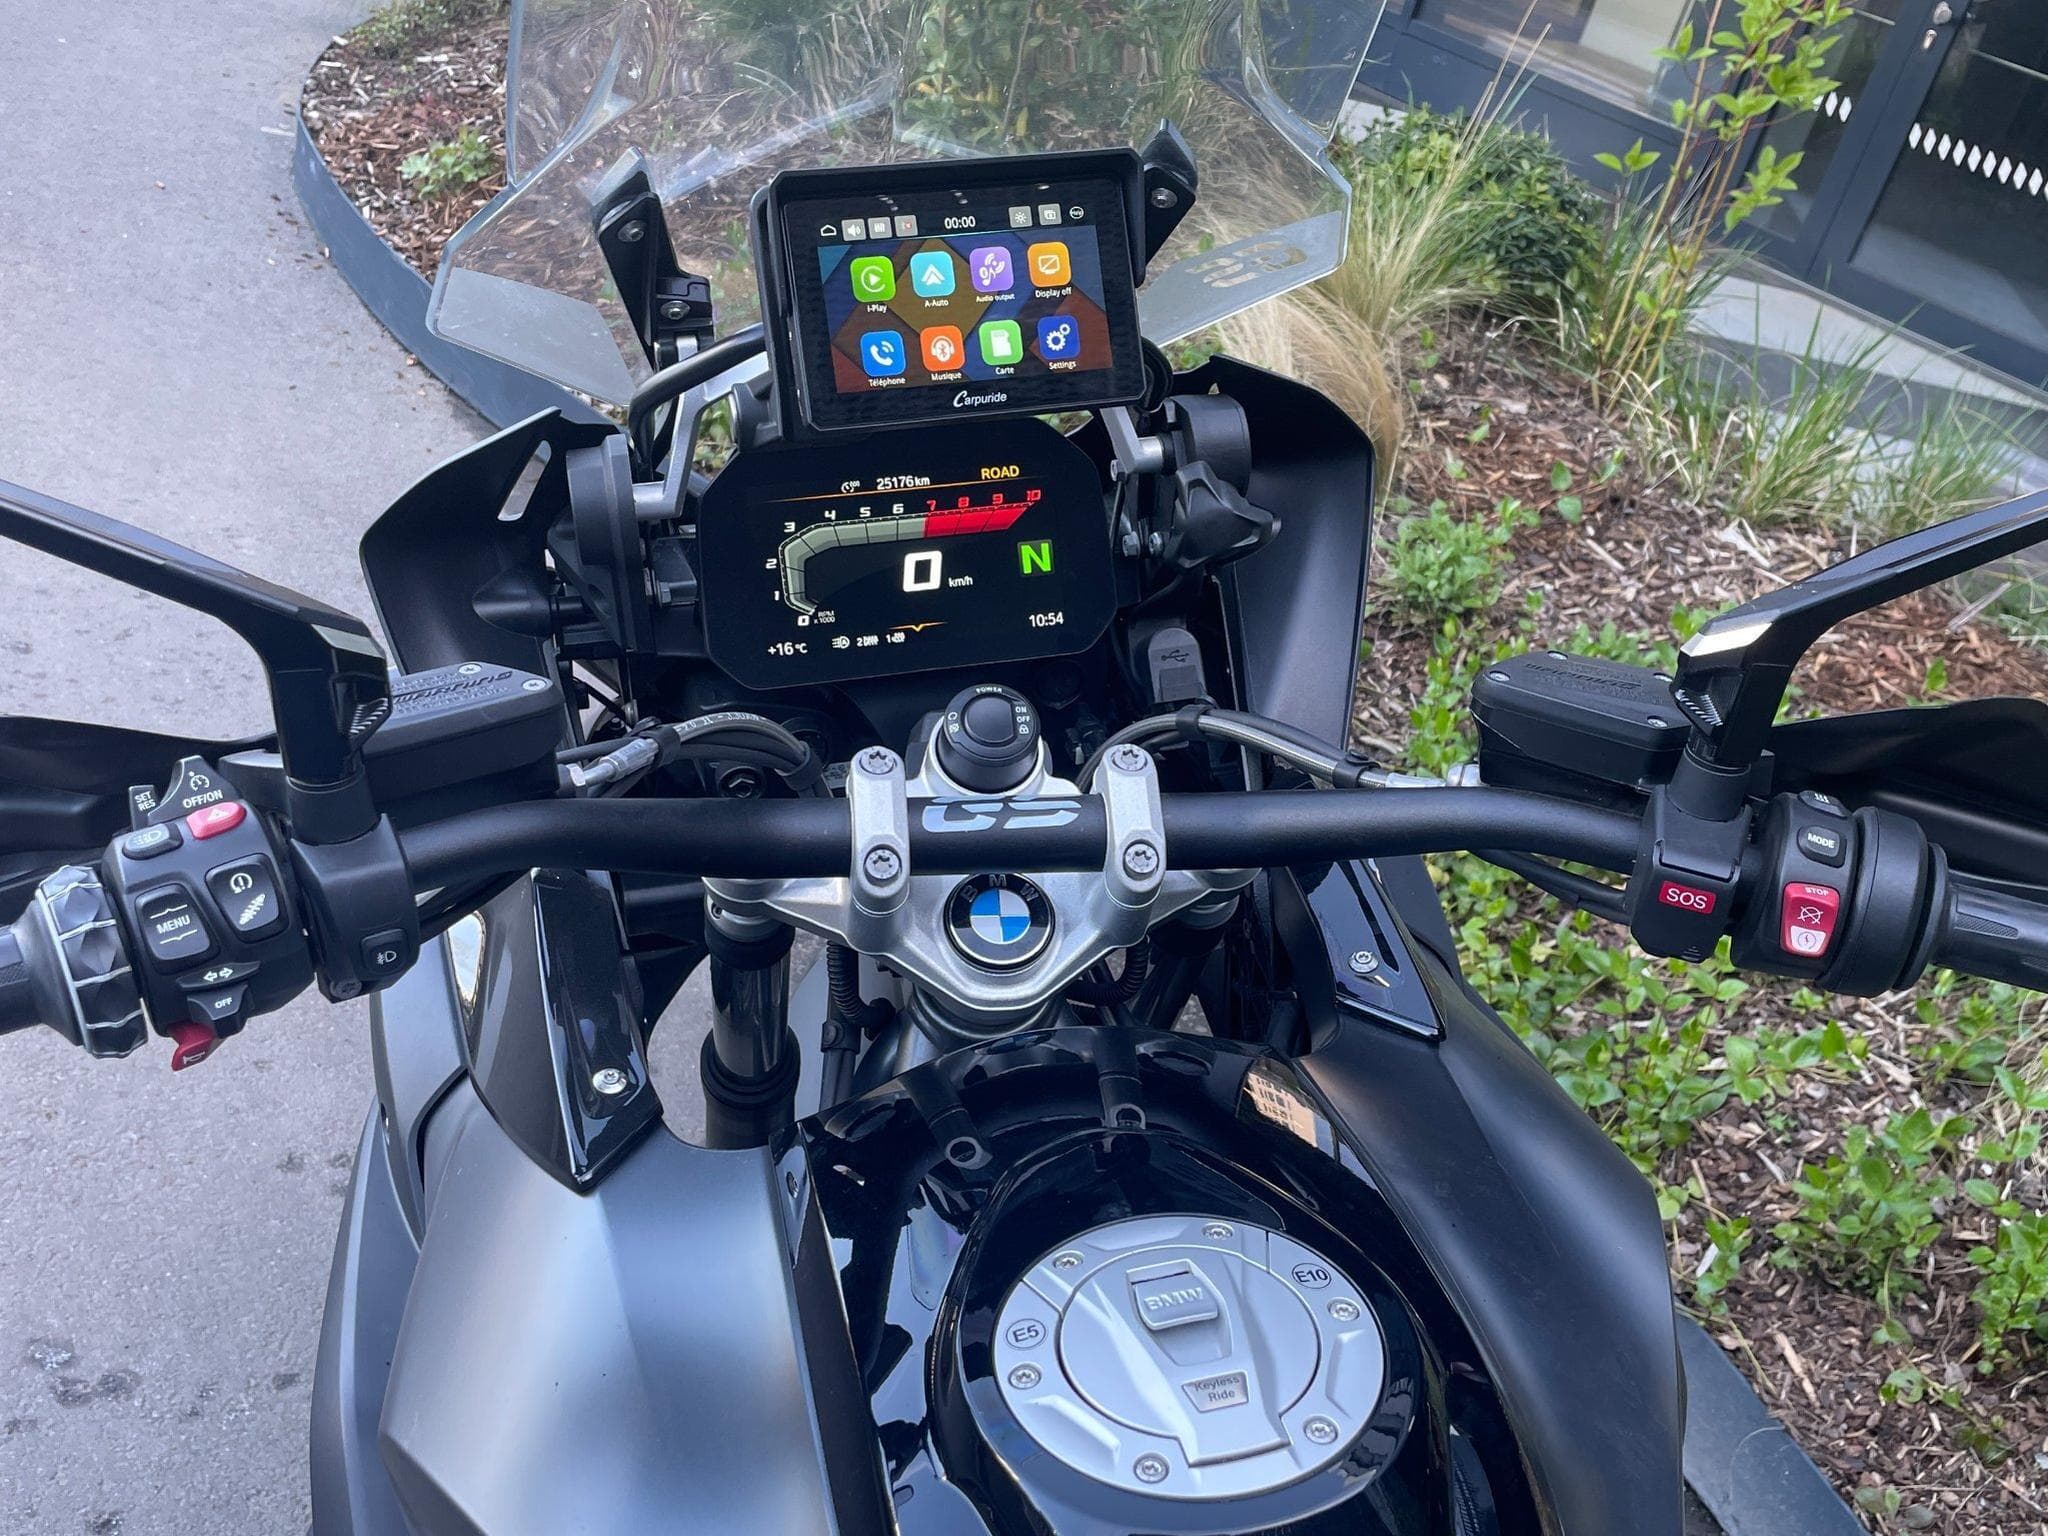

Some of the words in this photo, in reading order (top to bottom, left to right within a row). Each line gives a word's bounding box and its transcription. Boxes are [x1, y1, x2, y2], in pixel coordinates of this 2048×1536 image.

[944, 215, 976, 229] 00:00
[976, 294, 993, 302] Audio
[995, 293, 1015, 302] output
[1035, 289, 1060, 299] Display
[1061, 287, 1072, 297] off
[924, 300, 949, 308] A-Auto
[995, 366, 1014, 376] Carte
[1049, 360, 1077, 371] Settings
[869, 376, 906, 388] Téléphone
[931, 371, 962, 382] Musique
[953, 391, 1008, 408] Carpuride
[980, 464, 1020, 480] ROAD
[992, 493, 1004, 504] 9
[1026, 489, 1042, 501] 10
[926, 500, 937, 510] 7
[958, 497, 970, 507] 8
[824, 510, 836, 520] 4
[859, 507, 871, 517] 5
[892, 504, 904, 514] 6
[784, 521, 796, 532] 3
[765, 559, 777, 569] 2
[1020, 542, 1052, 574] N
[902, 550, 943, 592] 0
[949, 575, 973, 588] km/h
[773, 591, 780, 601] 1
[797, 615, 810, 626] 0
[1029, 612, 1064, 628] 10:54
[134, 790, 151, 803] SET
[182, 789, 224, 808] OFF/ON
[137, 799, 156, 811] RES
[922, 796, 1082, 833] GS
[1807, 832, 1835, 848] MODE
[1805, 886, 1830, 896] STOP
[1666, 887, 1708, 910] SOS
[156, 914, 191, 934] MENU
[214, 997, 233, 1009] OFF
[1294, 1268, 1328, 1285] E10
[1144, 1287, 1203, 1310] BMW
[1012, 1324, 1039, 1343] E5
[1194, 1376, 1240, 1391] Keyless
[1208, 1389, 1235, 1402] Ride
